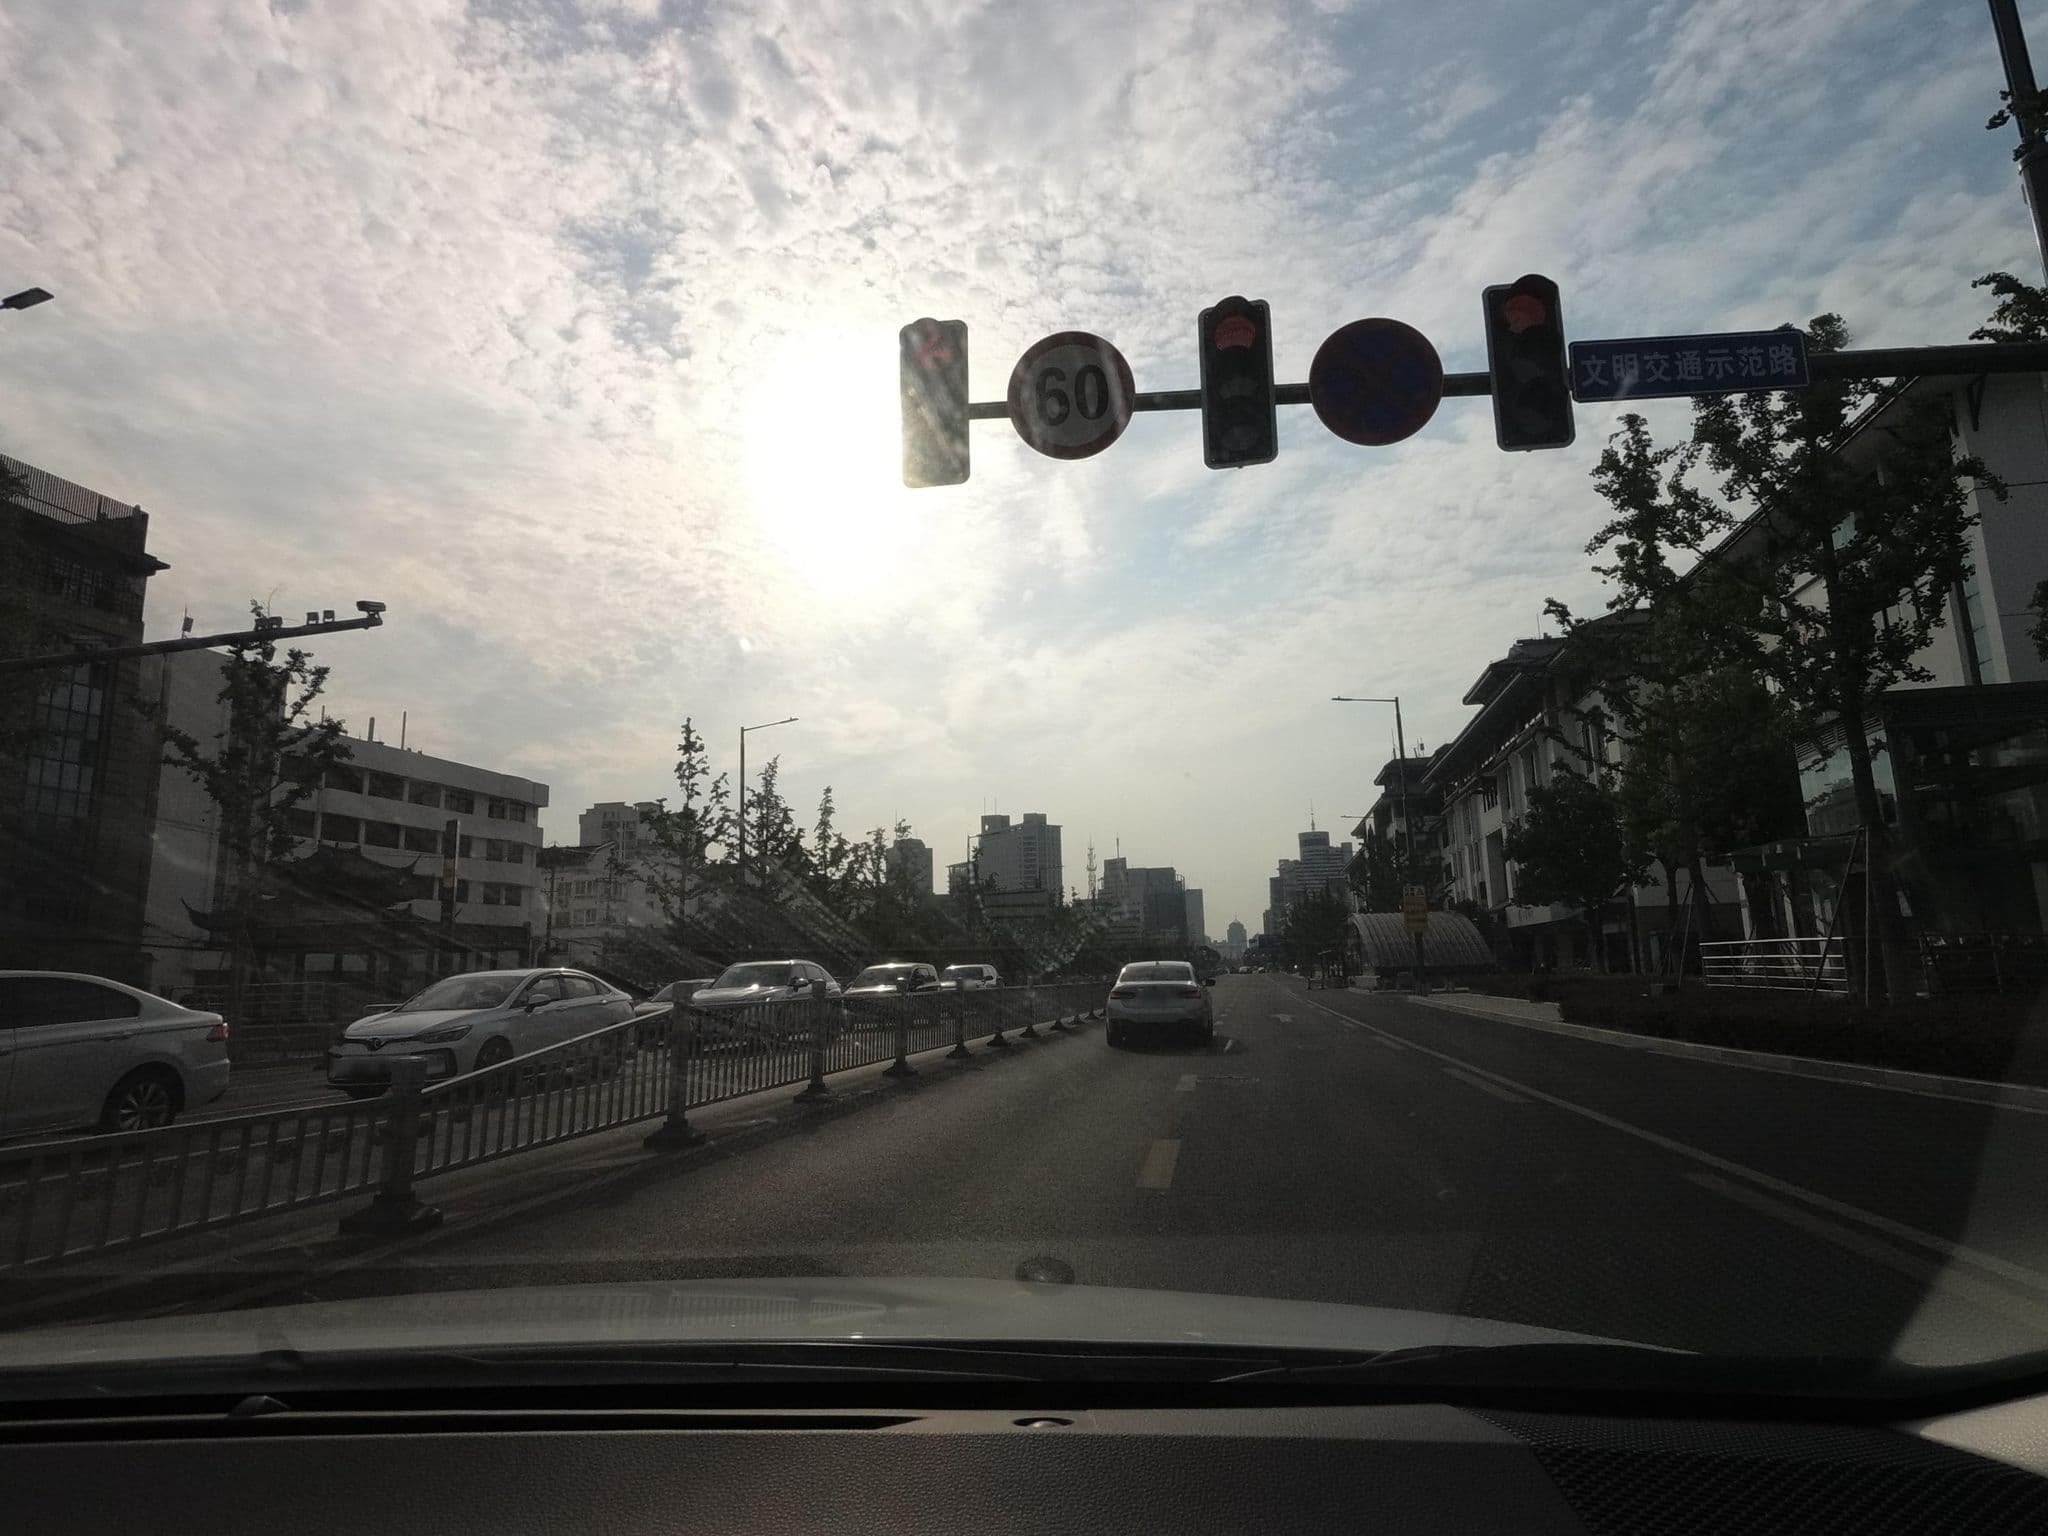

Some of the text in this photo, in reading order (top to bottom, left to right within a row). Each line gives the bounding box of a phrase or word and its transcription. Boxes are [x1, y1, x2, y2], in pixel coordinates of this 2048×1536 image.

[1580, 344, 1798, 387] 文明交通示范路
[1035, 365, 1109, 426] 60
